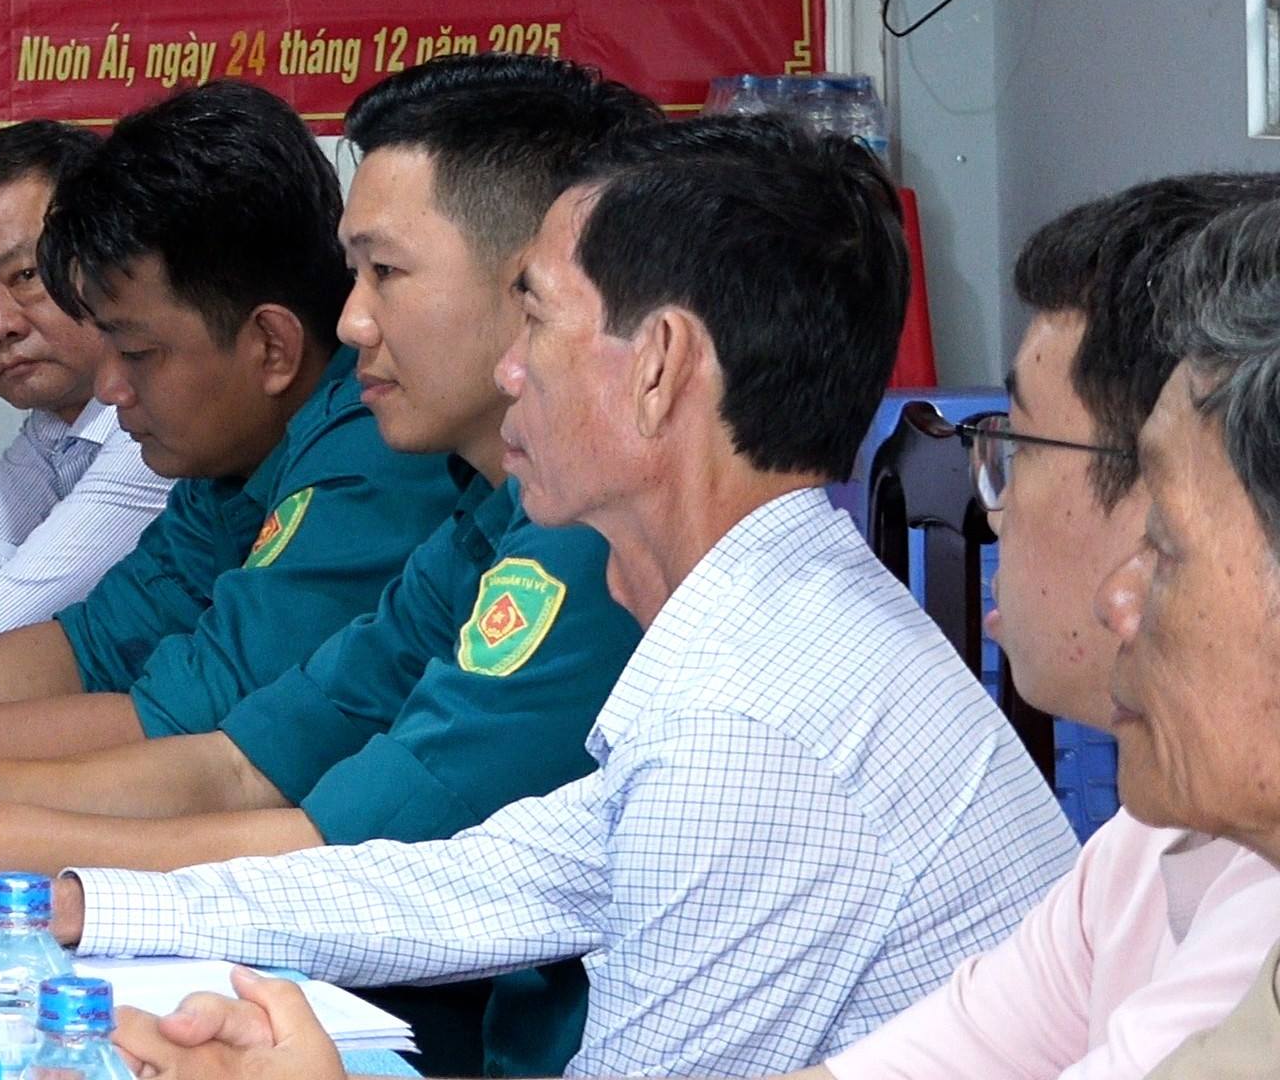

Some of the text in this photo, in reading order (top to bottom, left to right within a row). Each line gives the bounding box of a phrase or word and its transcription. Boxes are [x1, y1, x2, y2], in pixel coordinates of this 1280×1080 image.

[17, 35, 90, 82] Nhơn
[97, 23, 135, 87] Ái,
[145, 31, 216, 89] ngày
[225, 30, 266, 76] 24
[279, 28, 361, 84] tháng
[373, 26, 406, 73] 12
